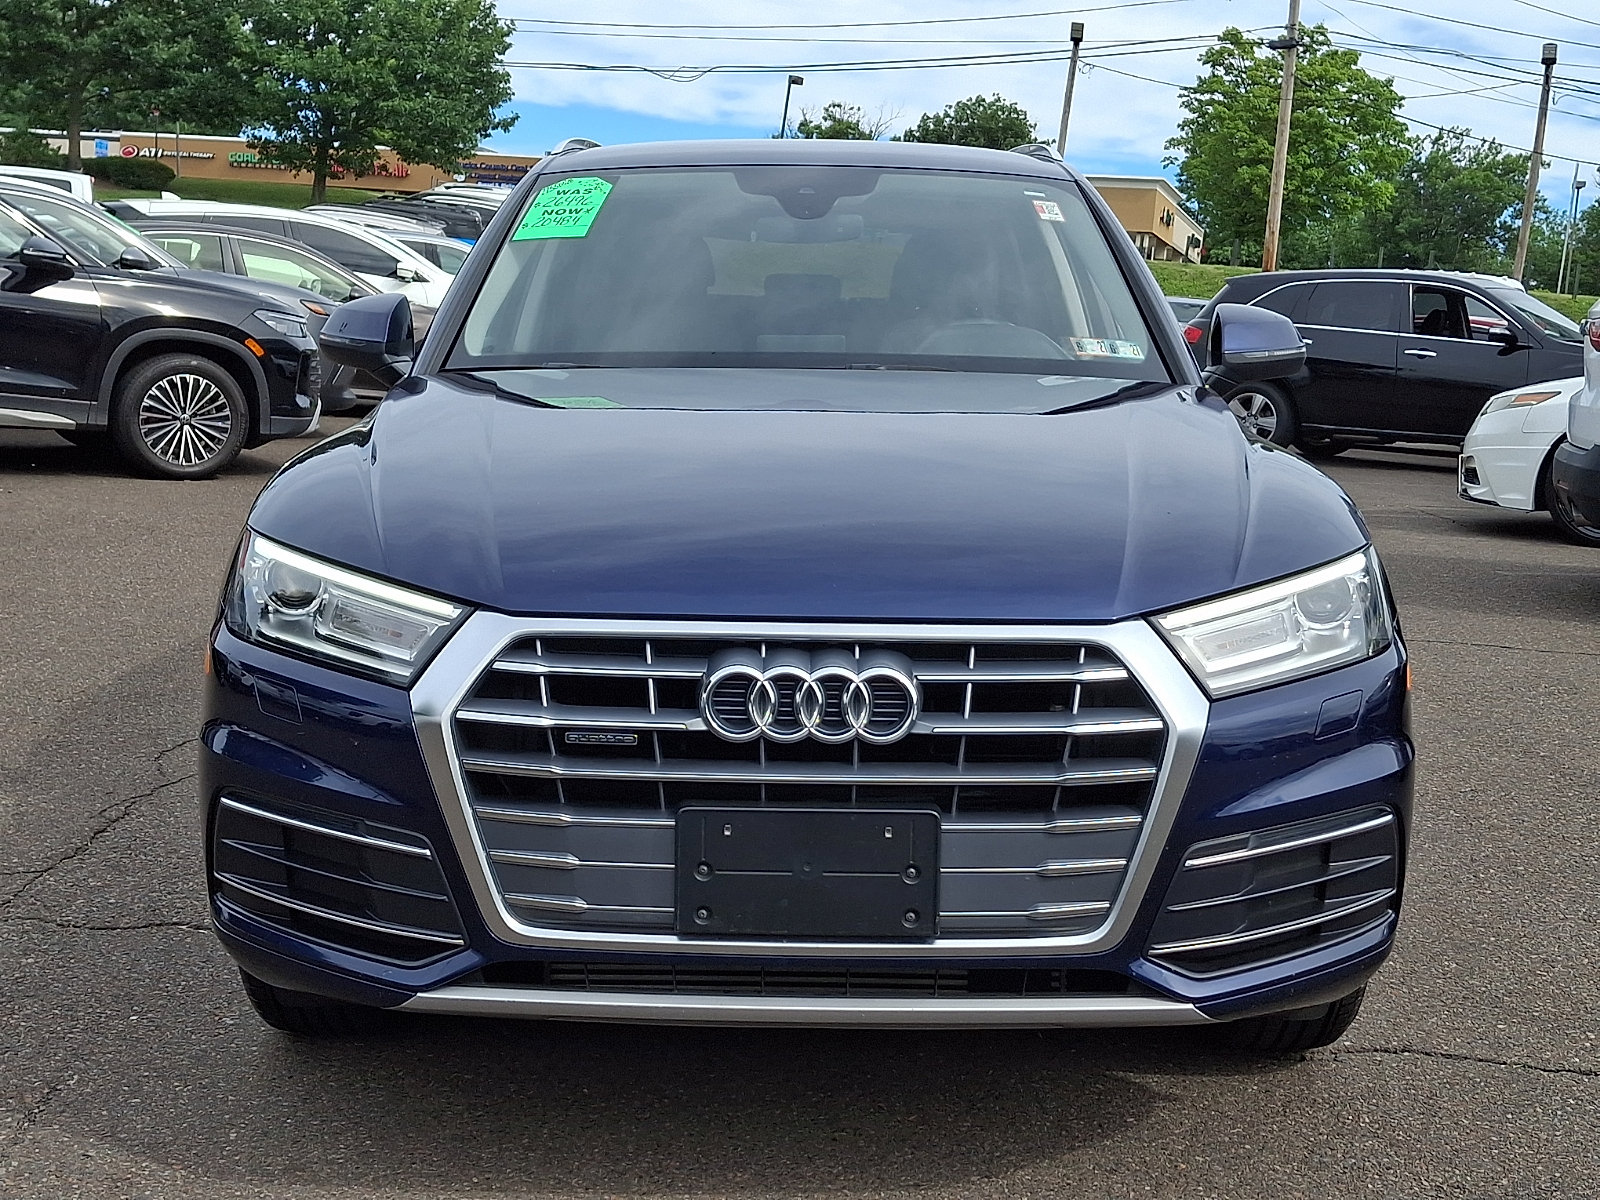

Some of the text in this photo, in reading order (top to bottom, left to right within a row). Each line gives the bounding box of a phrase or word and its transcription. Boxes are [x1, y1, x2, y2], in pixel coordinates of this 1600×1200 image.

[139, 147, 163, 158] ATI
[556, 188, 593, 196] WAS
[542, 208, 584, 216] NOW
[568, 734, 635, 743] quattro
